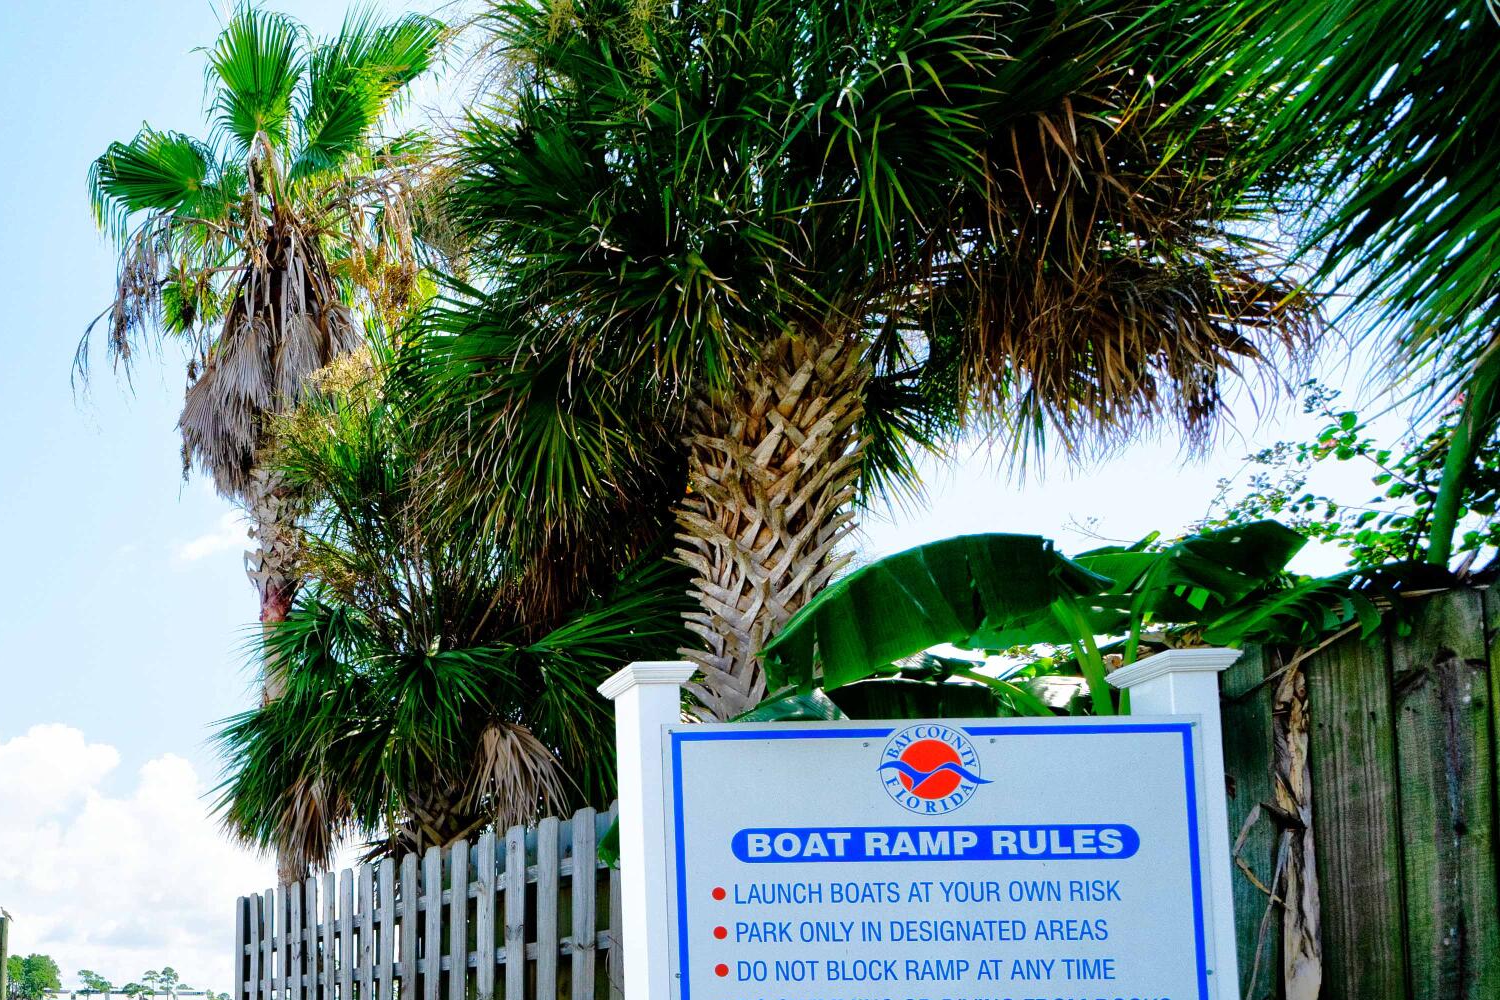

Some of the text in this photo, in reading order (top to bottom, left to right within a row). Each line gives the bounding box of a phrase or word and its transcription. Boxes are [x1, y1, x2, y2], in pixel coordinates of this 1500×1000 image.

[886, 726, 977, 768] BAY COUNTY
[885, 776, 974, 813] FLORIDA
[748, 830, 1122, 857] BOAT RAMP RULES
[735, 880, 1121, 904] LAUNCH BOATS AT YOUR OWN RISK
[736, 919, 1108, 942] PARK ONLY IN DESIGNATED AREAS
[738, 959, 1115, 981] DO NOT BLOCK RAMP AT ANY TIME
